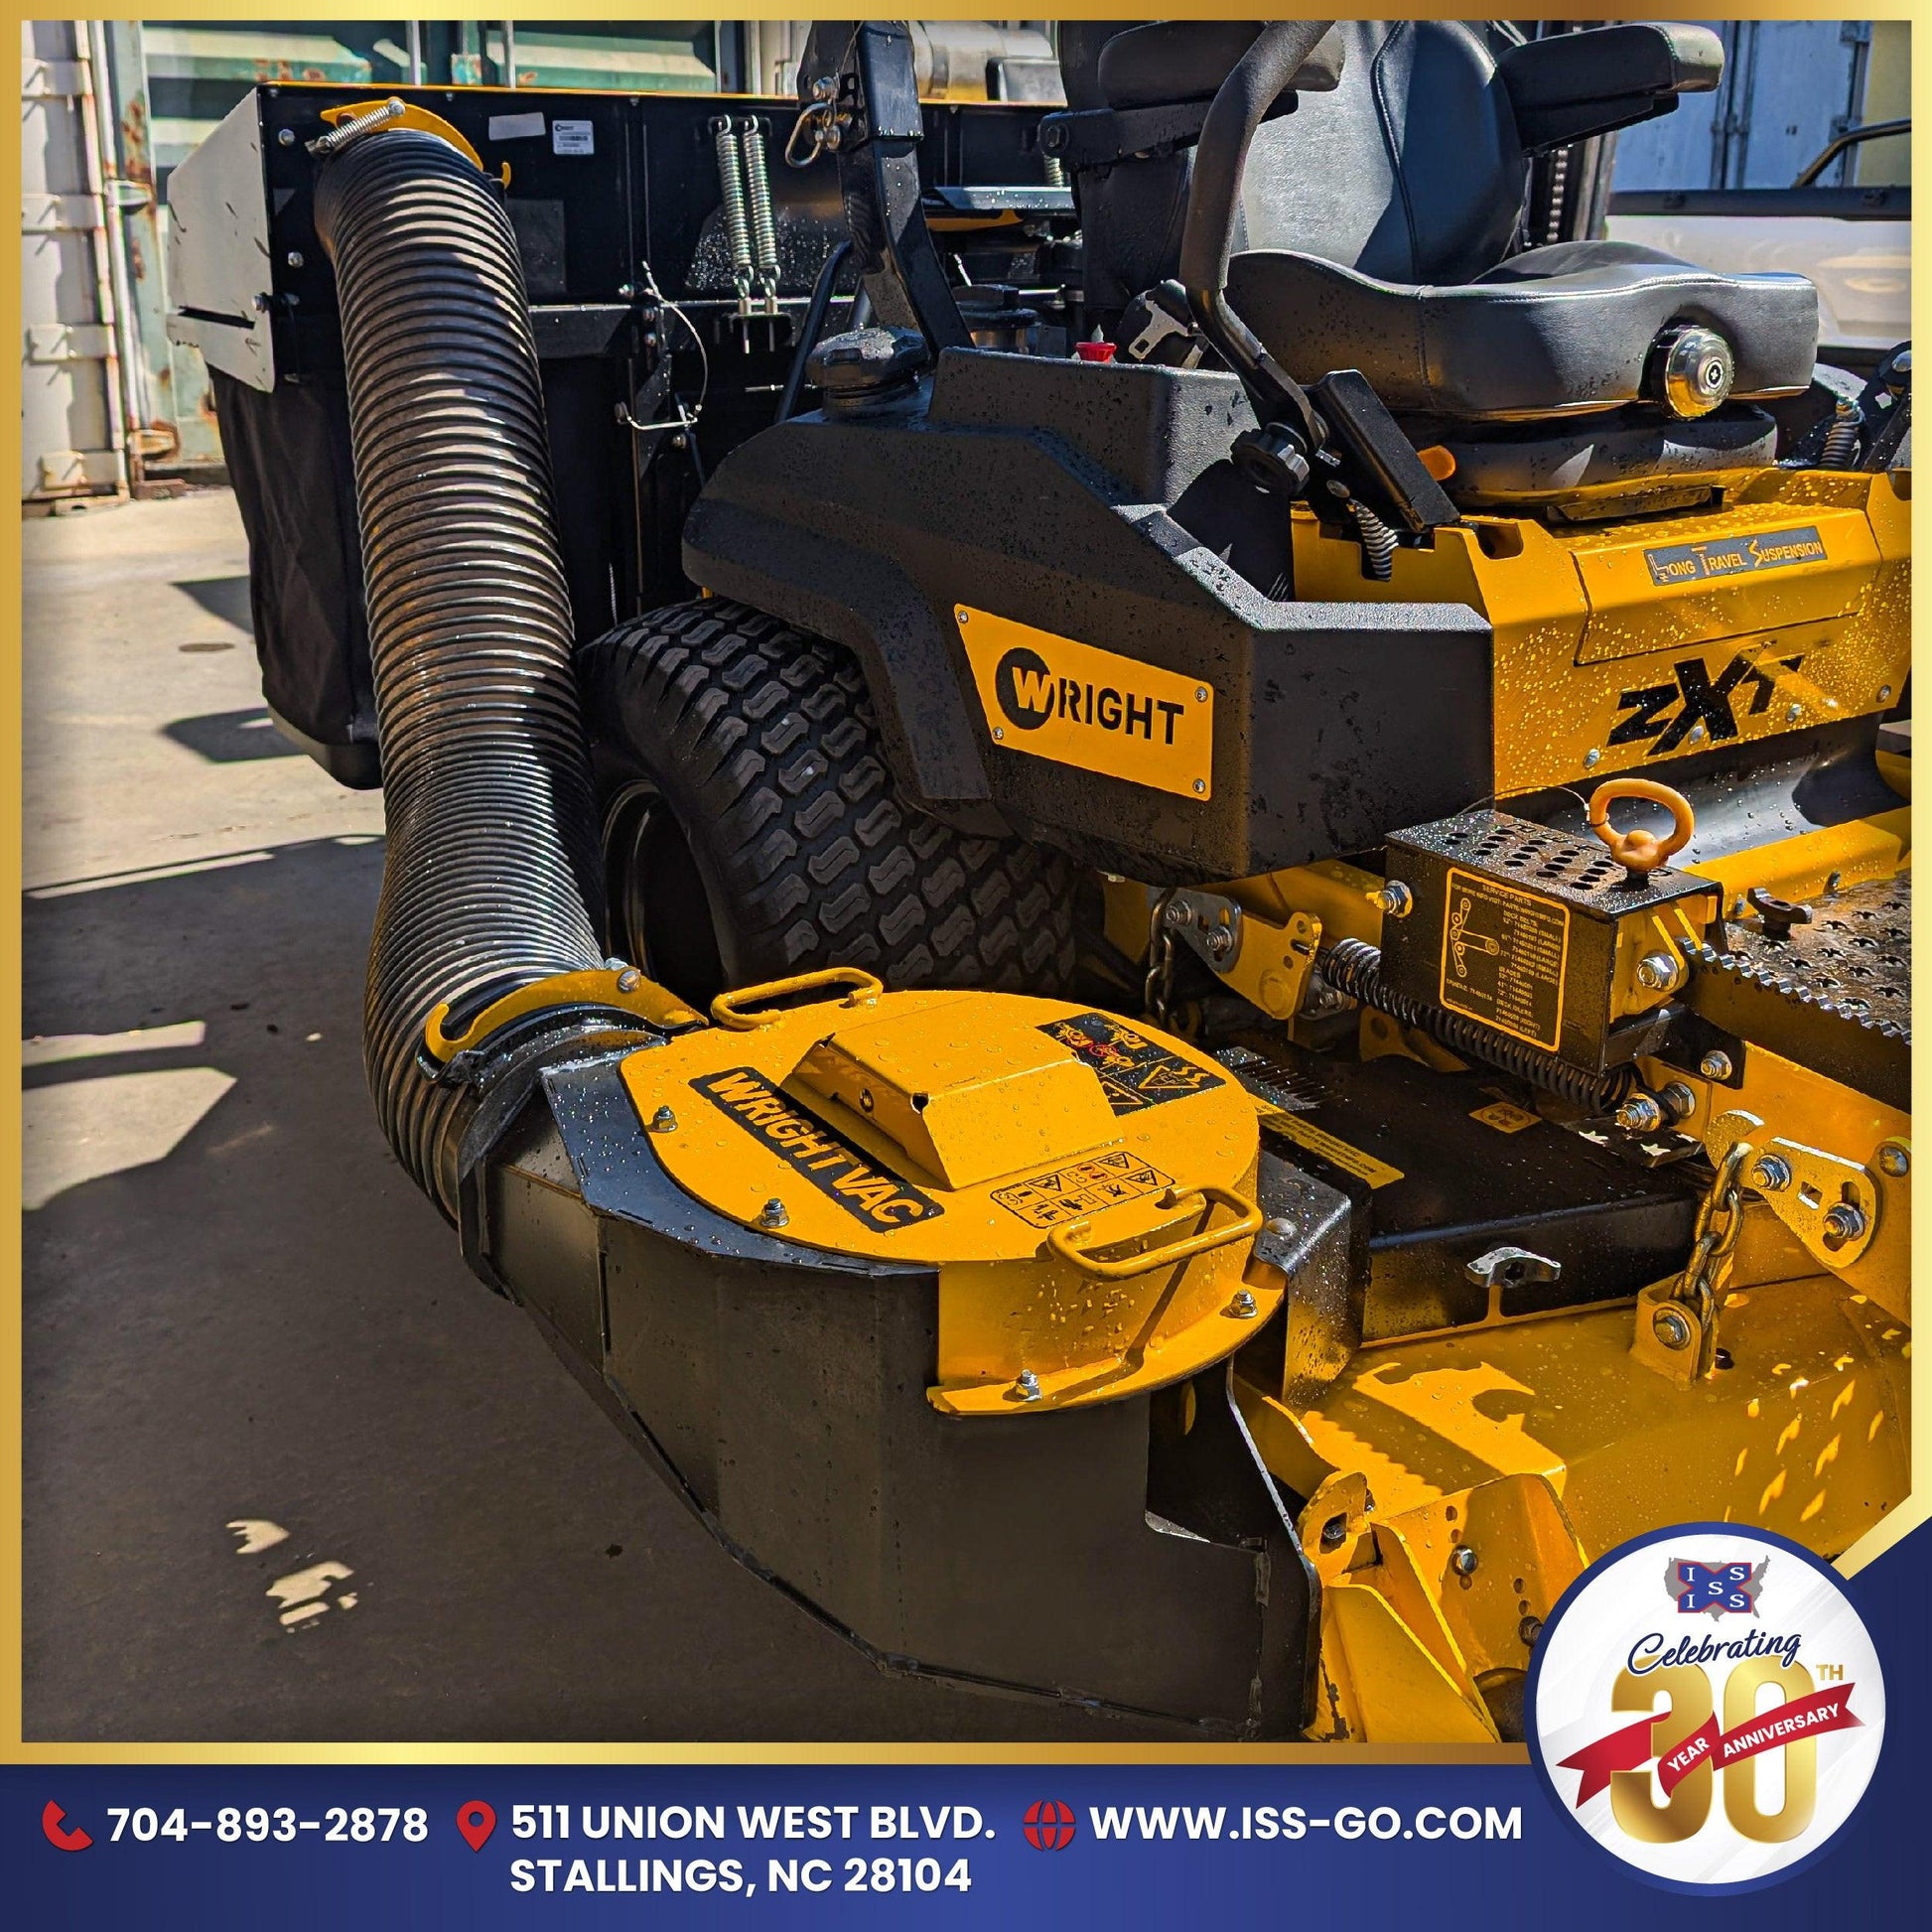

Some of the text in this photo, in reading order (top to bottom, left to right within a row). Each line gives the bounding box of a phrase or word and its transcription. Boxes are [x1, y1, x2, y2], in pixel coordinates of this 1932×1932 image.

[1647, 539, 1824, 583] LONG TRAVEL SUSPENSION
[995, 646, 1184, 745] WRIGHT
[1481, 885, 1531, 906] SERVICE PARTS
[707, 1071, 924, 1224] WRIGHT VAC
